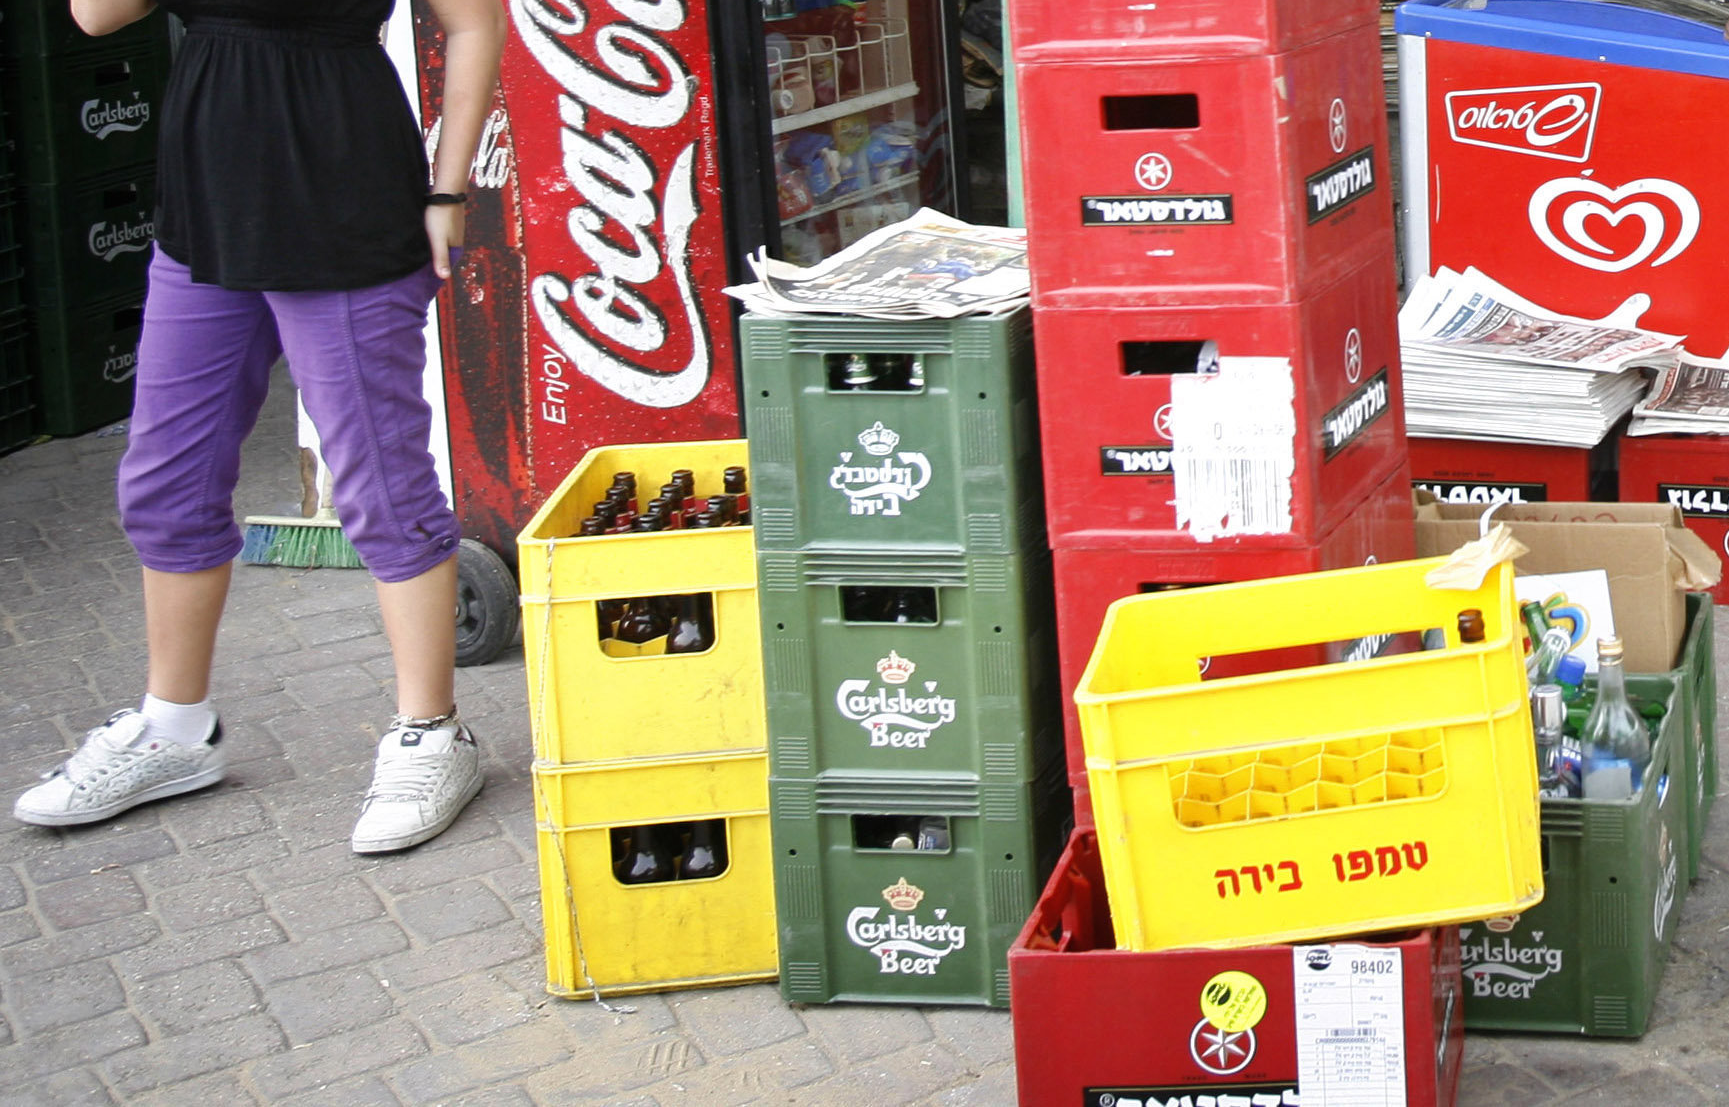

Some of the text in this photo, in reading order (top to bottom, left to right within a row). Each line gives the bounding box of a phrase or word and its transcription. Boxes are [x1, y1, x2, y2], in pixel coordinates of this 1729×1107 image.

[81, 92, 150, 139] Carlsberg
[1313, 157, 1373, 213] גולדסטאר
[1096, 198, 1226, 222] גולדסטאר
[541, 344, 568, 425] Enjoy
[829, 451, 933, 500] קרלסברג
[848, 496, 901, 516] בירה
[836, 679, 956, 730] Carlsberg
[870, 723, 932, 750] Beer
[1214, 841, 1429, 899] טמפו בירה
[846, 906, 965, 956] Carlsberg
[879, 951, 940, 975] Beer
[1351, 960, 1394, 975] 98402
[1461, 930, 1563, 981] arlsberg
[1473, 972, 1535, 1000] Beer
